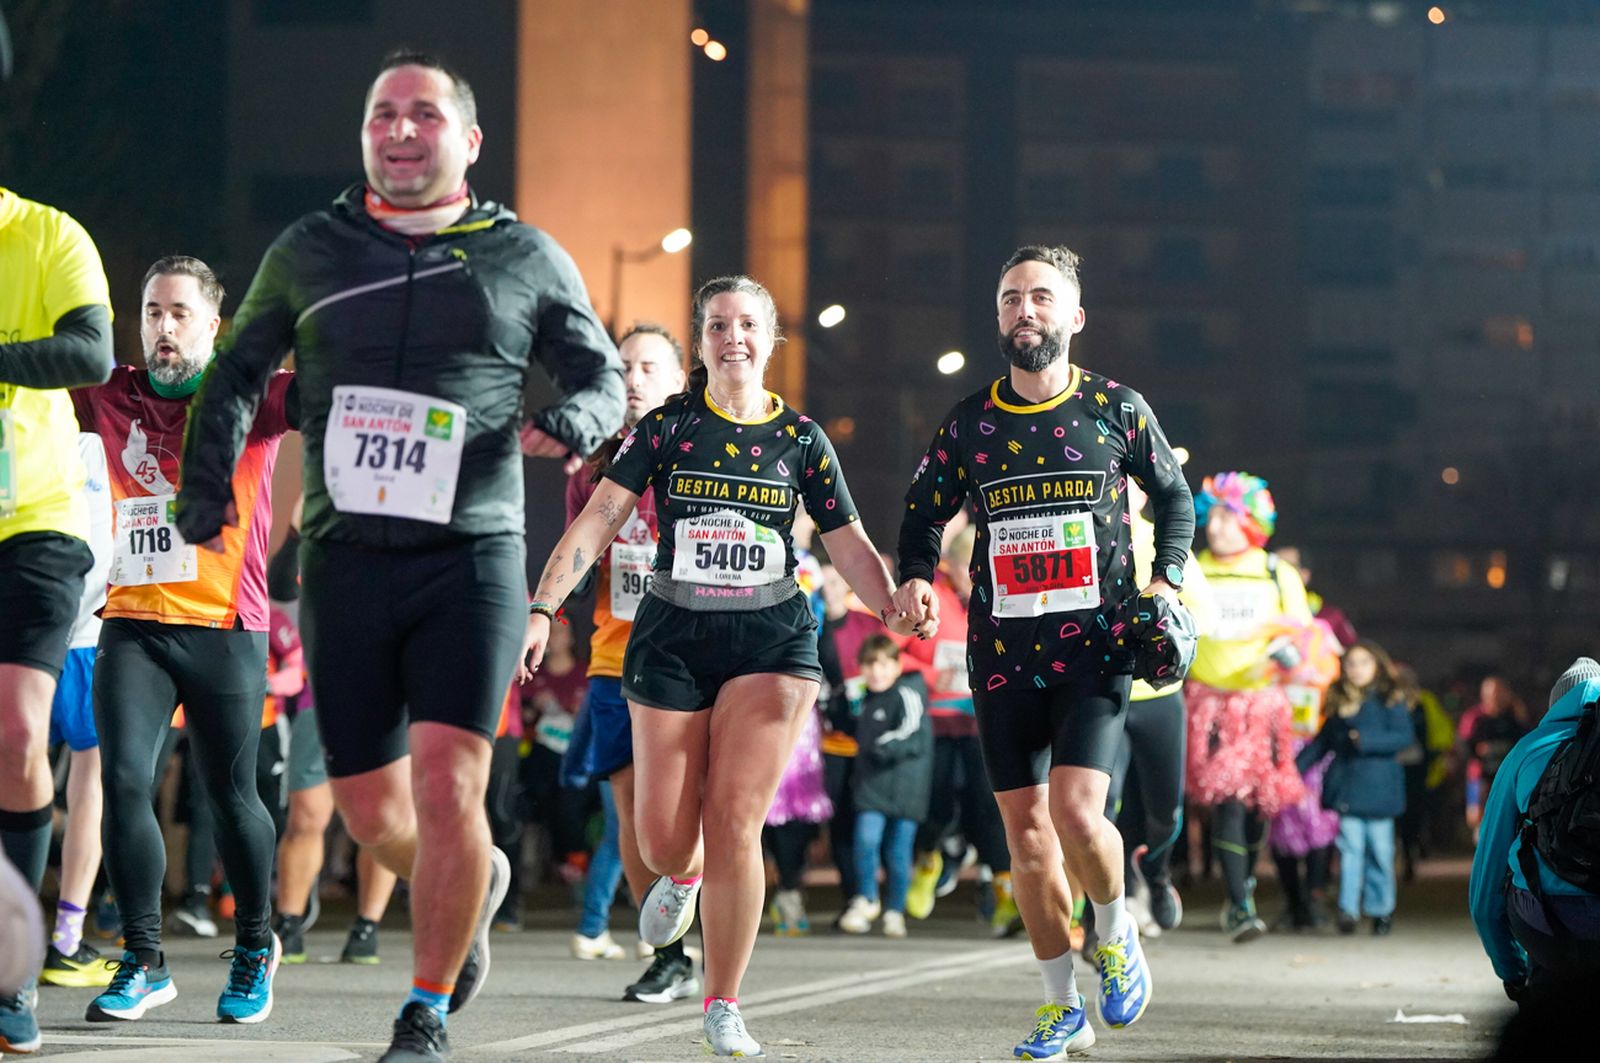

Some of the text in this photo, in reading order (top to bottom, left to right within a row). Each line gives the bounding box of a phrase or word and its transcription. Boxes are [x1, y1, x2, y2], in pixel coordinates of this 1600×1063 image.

[343, 416, 365, 428] SAN
[354, 433, 427, 473] 7314
[135, 460, 157, 484] 43
[676, 478, 786, 506] BESTIA PARDA
[989, 480, 1094, 509] BESTIA PARDA
[148, 506, 158, 515] DE
[686, 505, 698, 513] BY
[701, 517, 746, 528] NOCHE DE
[128, 527, 171, 555] 1718
[629, 526, 648, 544] 43
[688, 529, 709, 539] SAN
[711, 528, 746, 541] ANTÓN
[1009, 530, 1039, 541] NOCHE
[1042, 528, 1054, 538] DE
[999, 543, 1018, 554] SAN
[1021, 539, 1055, 553] ANTÓN
[695, 543, 766, 571] 5409
[1013, 551, 1073, 583] 5871
[714, 572, 742, 581] LORENA
